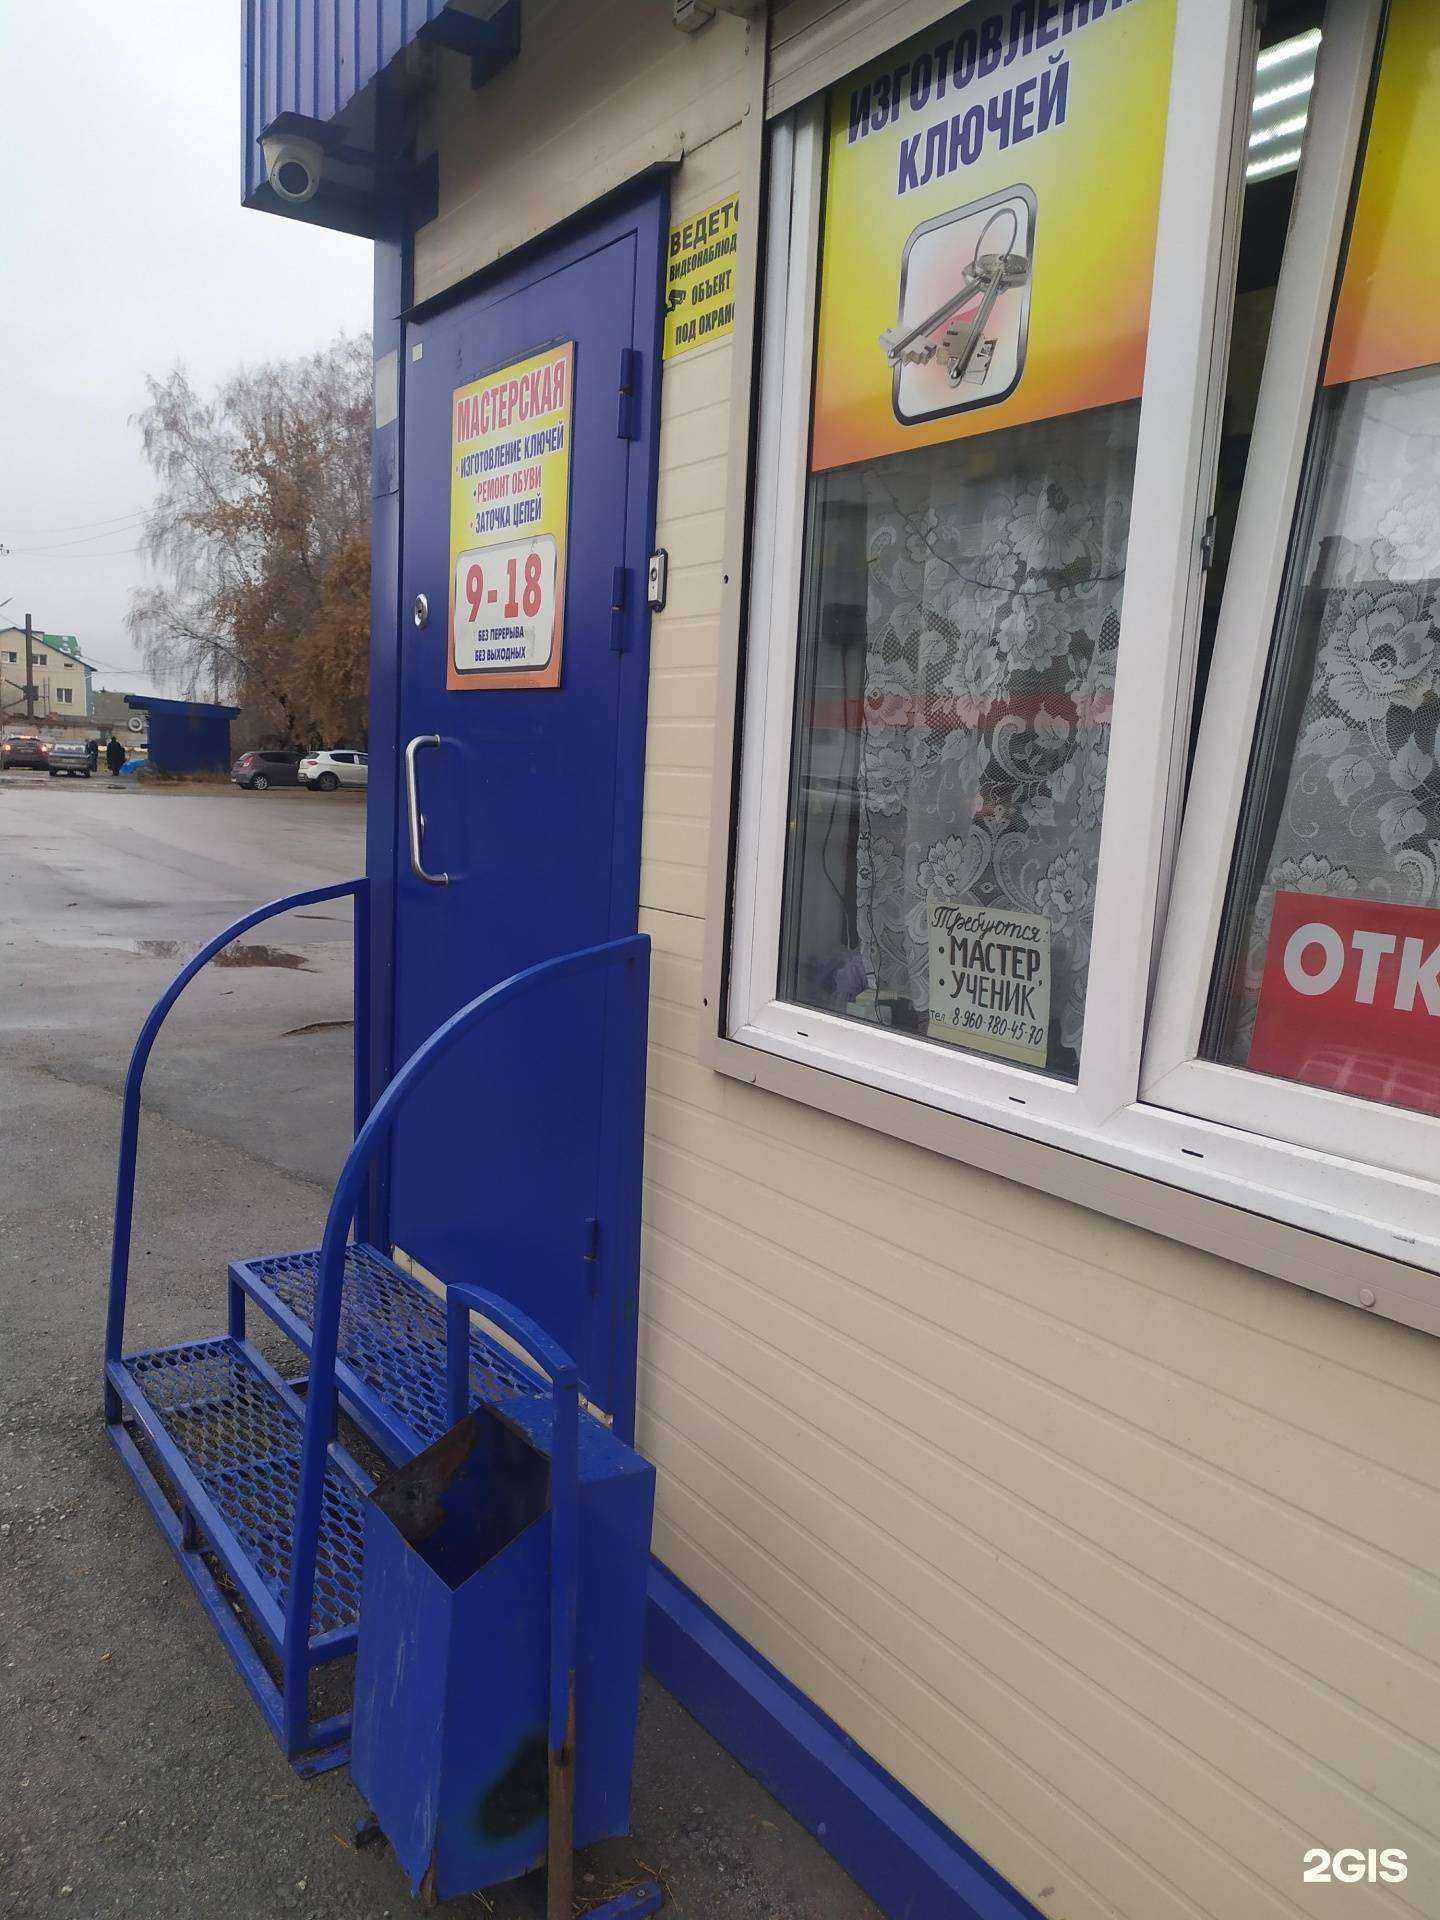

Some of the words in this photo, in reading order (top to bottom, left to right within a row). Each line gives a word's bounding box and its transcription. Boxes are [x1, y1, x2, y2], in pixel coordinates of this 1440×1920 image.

[848, 0, 1135, 144] ИЗГОТОВЛЕН
[898, 49, 1070, 195] КЛЮЧЕЙ
[691, 269, 732, 306] ОБЪЕКТ
[675, 319, 697, 345] ПОД
[457, 360, 566, 443] МАСТЕРСКАЯ
[460, 438, 522, 479] ИЗГОТОВЛЕНИЕ
[524, 420, 565, 459] КЛЮЧЕЙ
[477, 474, 510, 503] РЕМОНТ
[511, 465, 542, 494] ОБУВИ
[475, 508, 511, 534] ЗАТОЧКА
[513, 493, 542, 528] ЦЕПЕЙ
[465, 553, 542, 622] 9-18
[474, 649, 486, 662] БЕЗ
[486, 646, 527, 662] ВЫХОДНЫХ
[478, 629, 489, 642] БЕЗ
[490, 626, 525, 641] ПЕРЕРЫВА
[949, 970, 1036, 1020] УЧЕНИК
[1283, 922, 1440, 1018] ОТК
